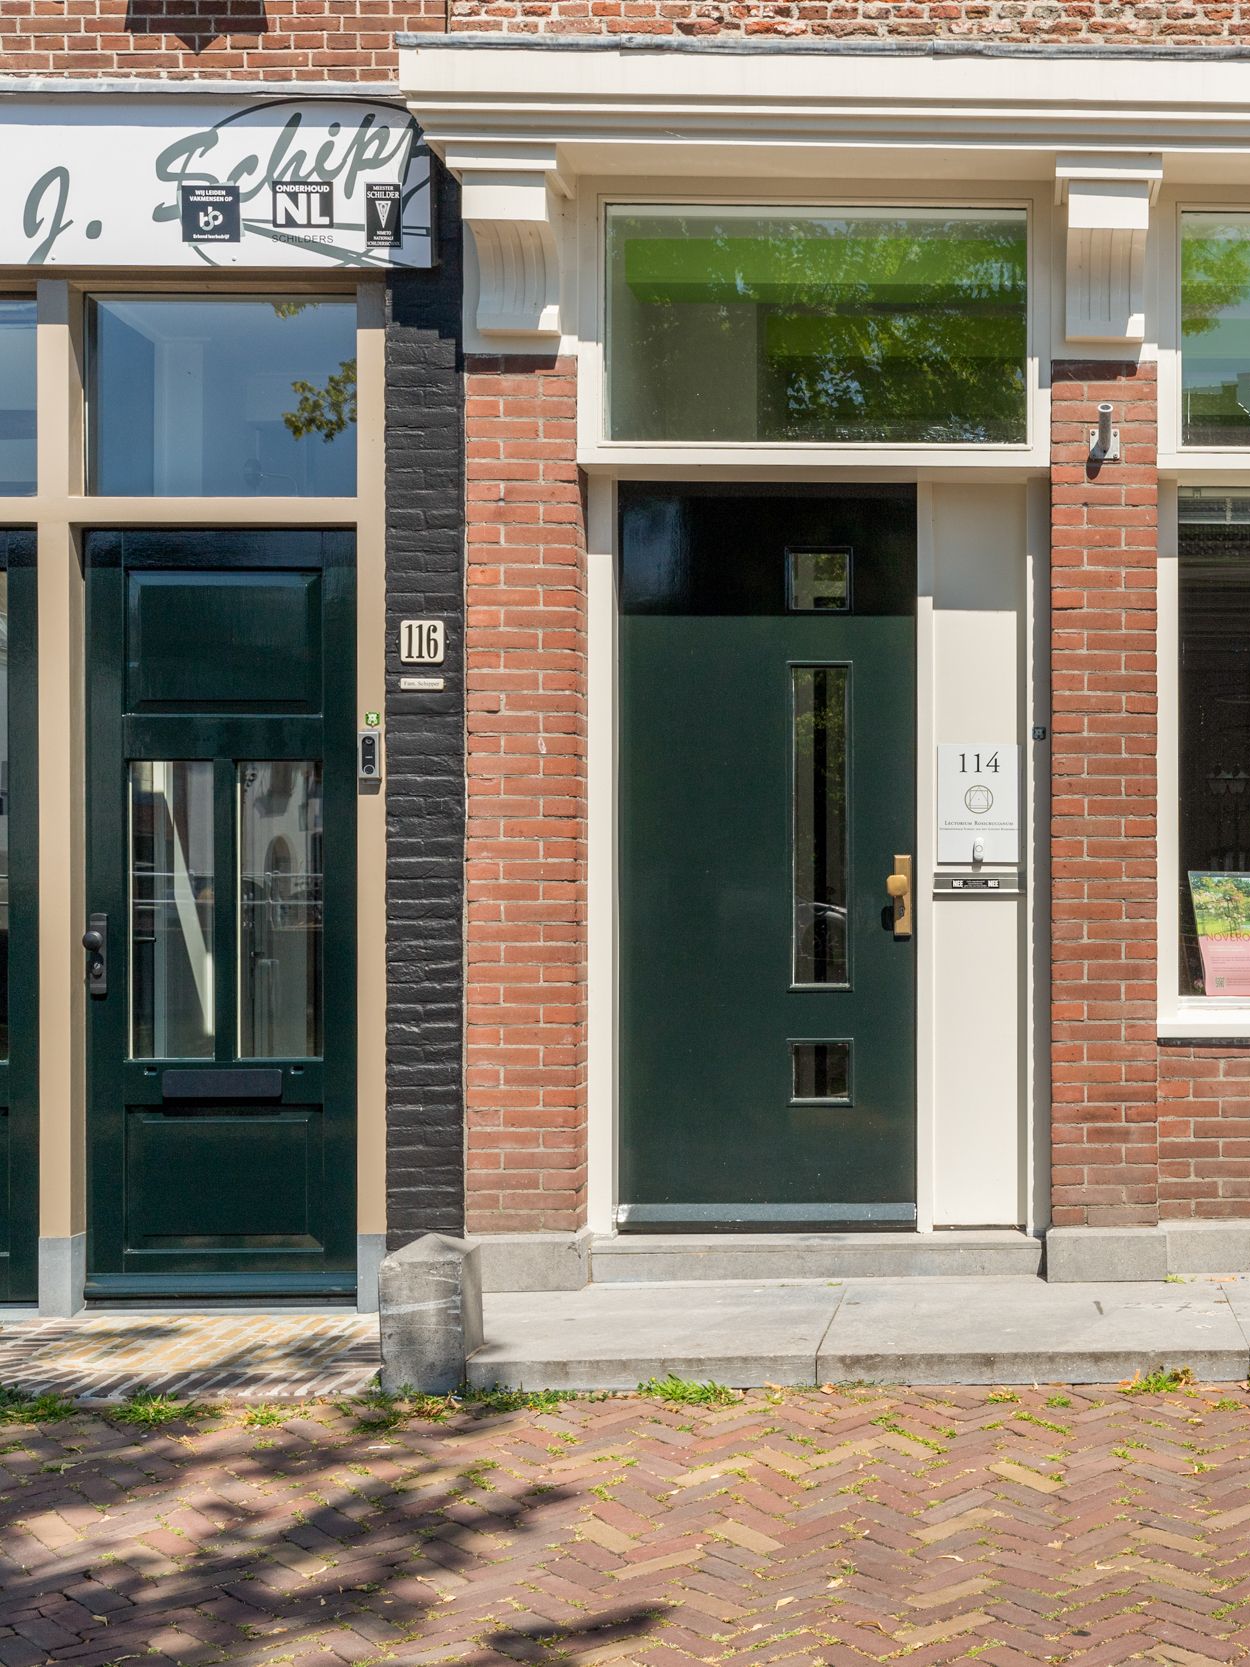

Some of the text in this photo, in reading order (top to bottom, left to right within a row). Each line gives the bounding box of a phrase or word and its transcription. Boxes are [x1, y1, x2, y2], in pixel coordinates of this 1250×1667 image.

[276, 193, 330, 225] NL
[271, 234, 334, 243] SCHILDERS
[404, 624, 439, 659] 116
[959, 751, 1000, 773] 114
[952, 880, 964, 888] NEE
[987, 880, 999, 888] NEE
